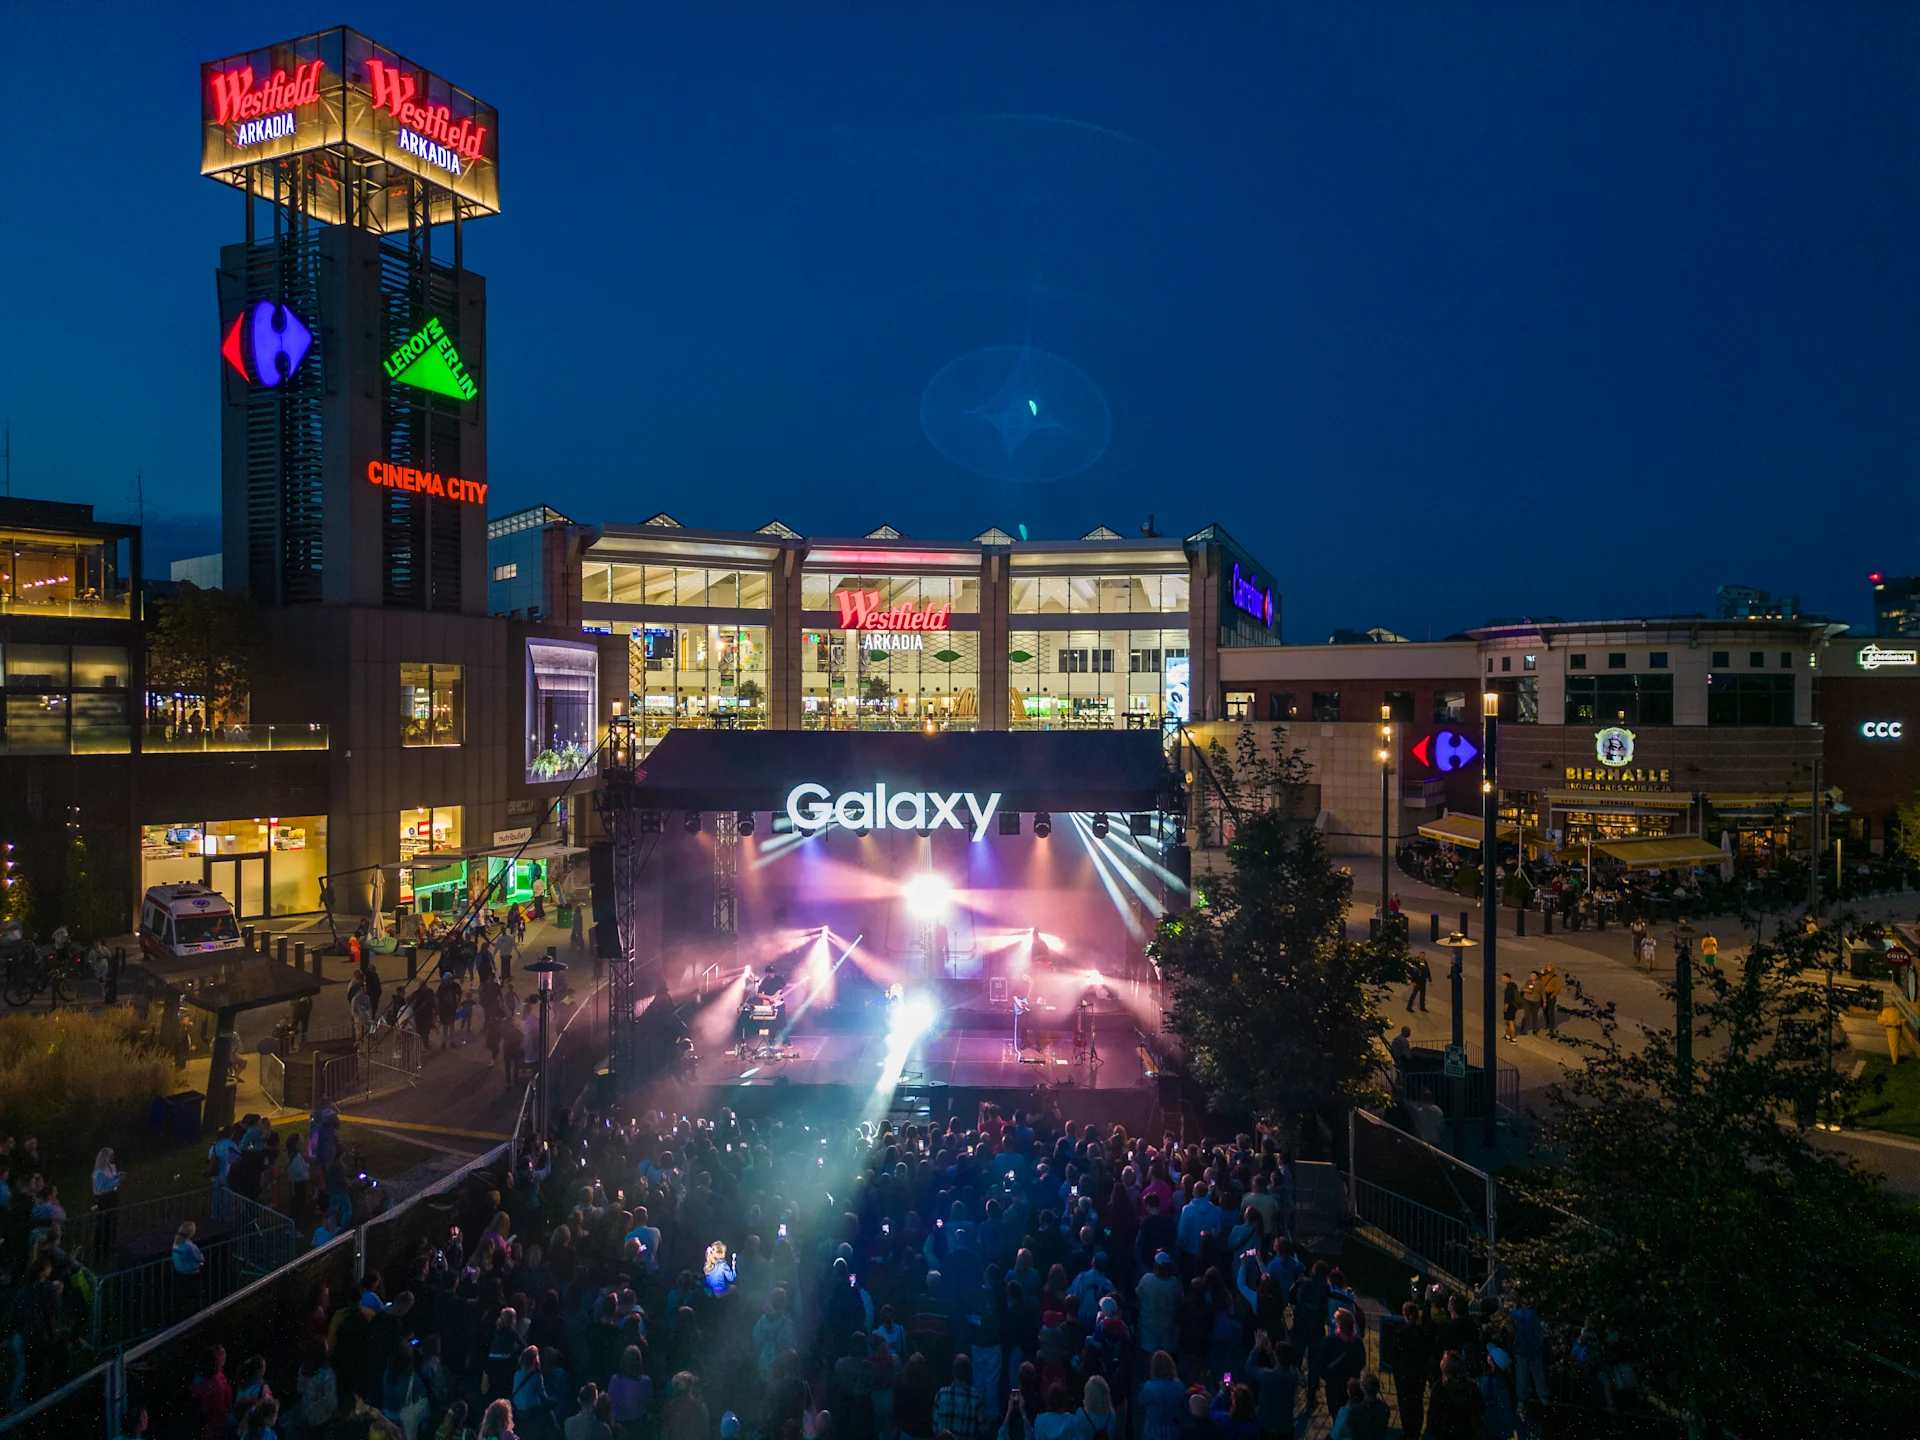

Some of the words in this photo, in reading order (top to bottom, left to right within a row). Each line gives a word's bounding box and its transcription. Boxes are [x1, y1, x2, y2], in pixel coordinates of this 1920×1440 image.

[211, 59, 325, 126] Westfield
[365, 59, 487, 160] Westfield
[238, 112, 297, 146] ARKADIA
[400, 128, 461, 175] ARKADIA
[383, 327, 432, 378] LEROY
[426, 316, 478, 400] MERLIN
[368, 460, 445, 497] CINEMA
[447, 477, 488, 505] CITY
[834, 589, 952, 631] Westfield
[863, 634, 924, 651] ARKADIA
[1863, 721, 1903, 738] CCC
[1566, 767, 1669, 782] BIERHALLE
[786, 782, 1002, 843] Galaxy
